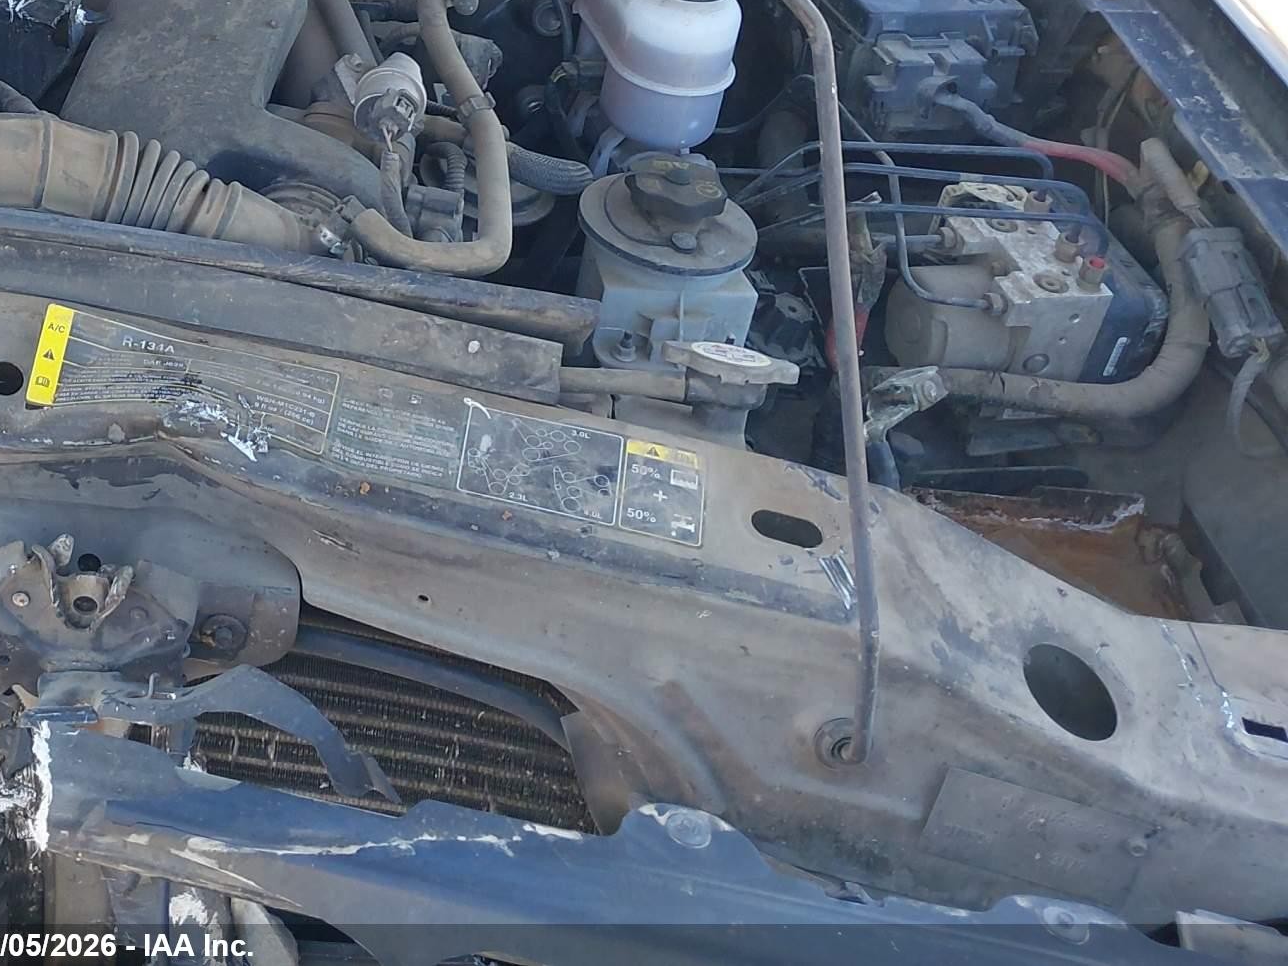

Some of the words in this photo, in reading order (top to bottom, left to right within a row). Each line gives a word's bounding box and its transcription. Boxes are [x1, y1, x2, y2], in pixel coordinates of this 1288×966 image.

[47, 322, 66, 335] A/C
[122, 335, 176, 354] R-134A
[630, 464, 661, 480] 50%
[626, 507, 657, 524] 50%
